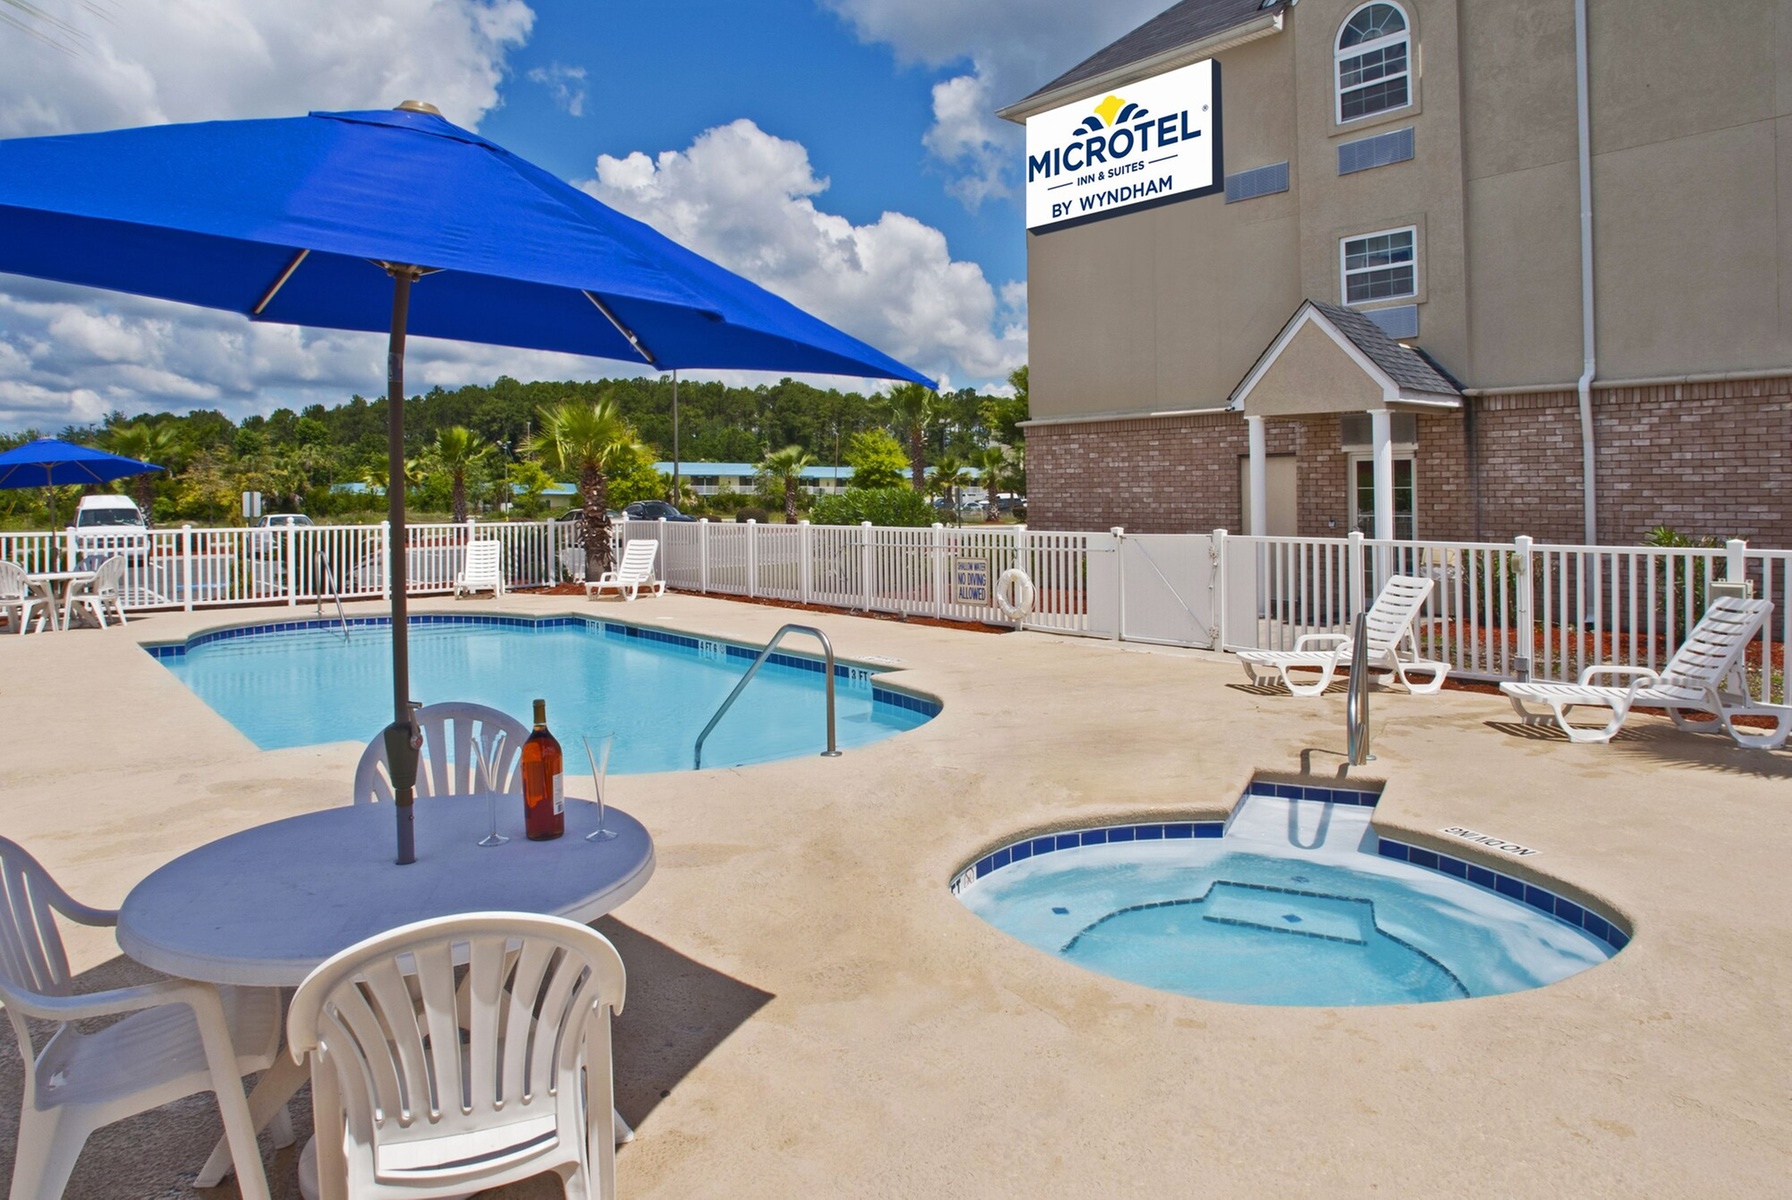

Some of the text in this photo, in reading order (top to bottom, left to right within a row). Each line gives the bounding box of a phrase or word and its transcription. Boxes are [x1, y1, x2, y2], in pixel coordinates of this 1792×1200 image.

[1028, 109, 1202, 183] MICROTEL
[1077, 160, 1145, 187] INN & SUITES
[1052, 175, 1173, 219] BY WYNDHAM
[957, 572, 986, 586] NO DIVING
[959, 587, 986, 600] ALLOWED
[705, 642, 712, 652] FT
[851, 669, 867, 681] 3 FT
[1444, 827, 1537, 856] NO DIVING
